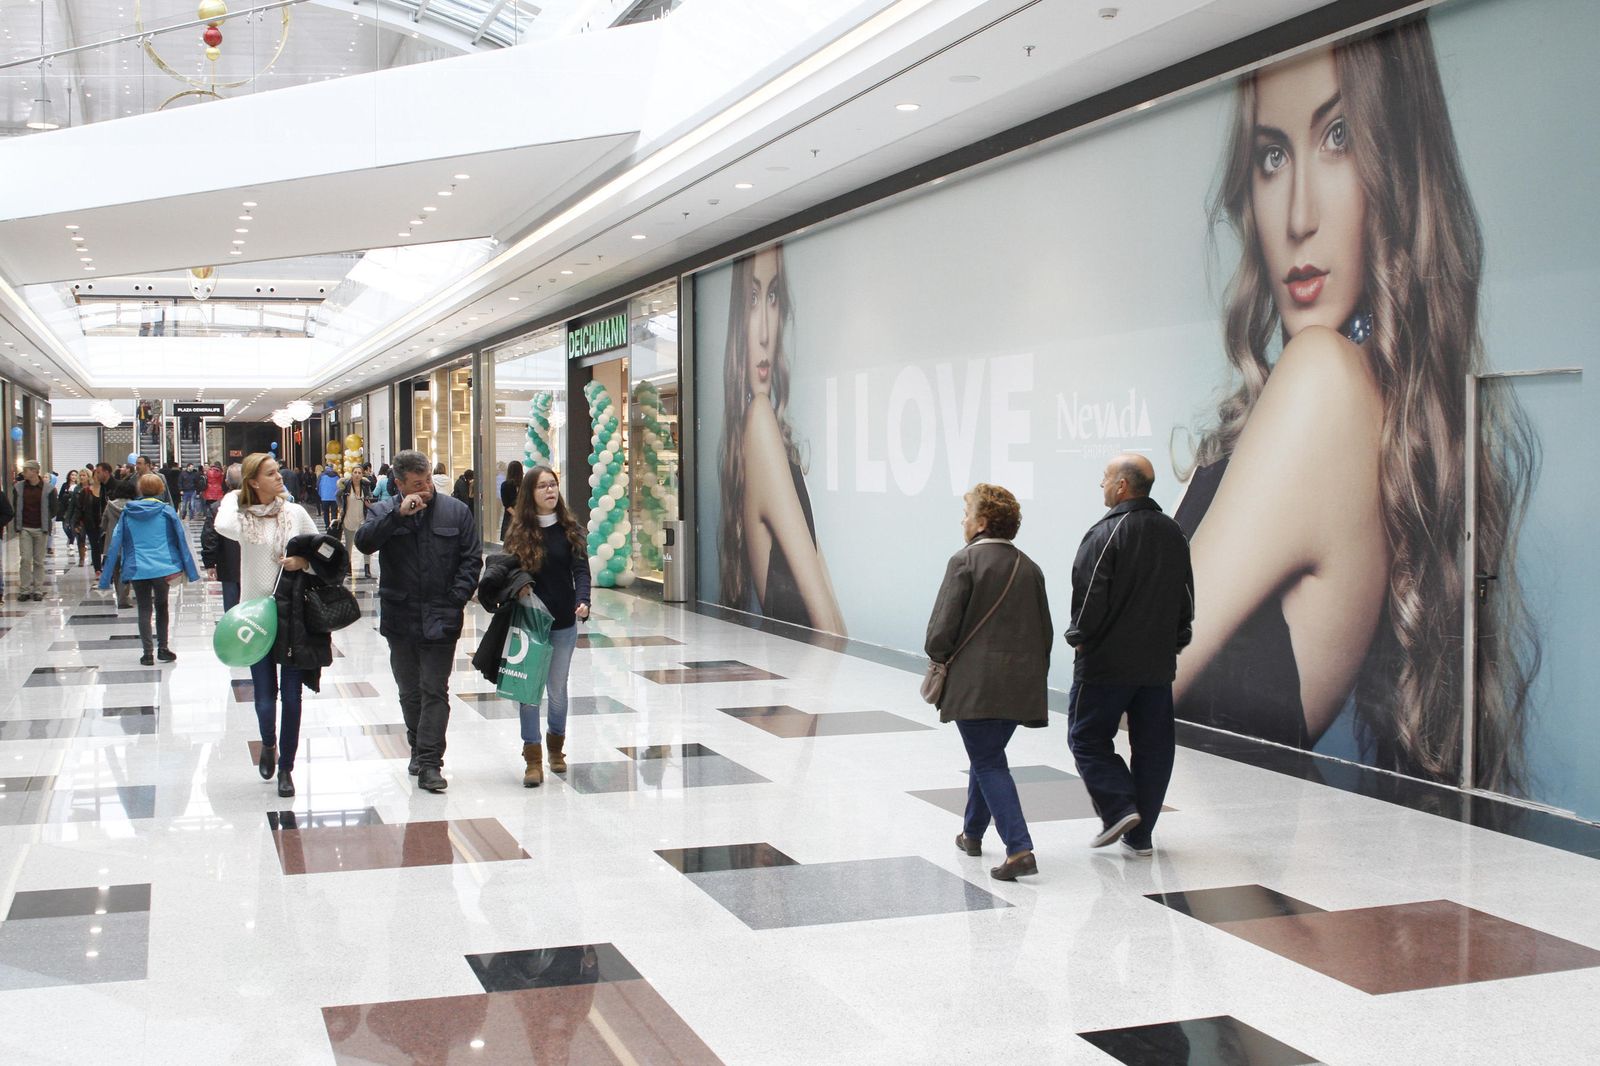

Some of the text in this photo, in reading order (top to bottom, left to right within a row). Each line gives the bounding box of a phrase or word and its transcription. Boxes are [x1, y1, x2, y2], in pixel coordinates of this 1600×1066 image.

[568, 313, 627, 360] DEICHMANN
[826, 353, 1034, 500] I LOVE
[1056, 387, 1152, 440] Nevada
[501, 626, 529, 665] D
